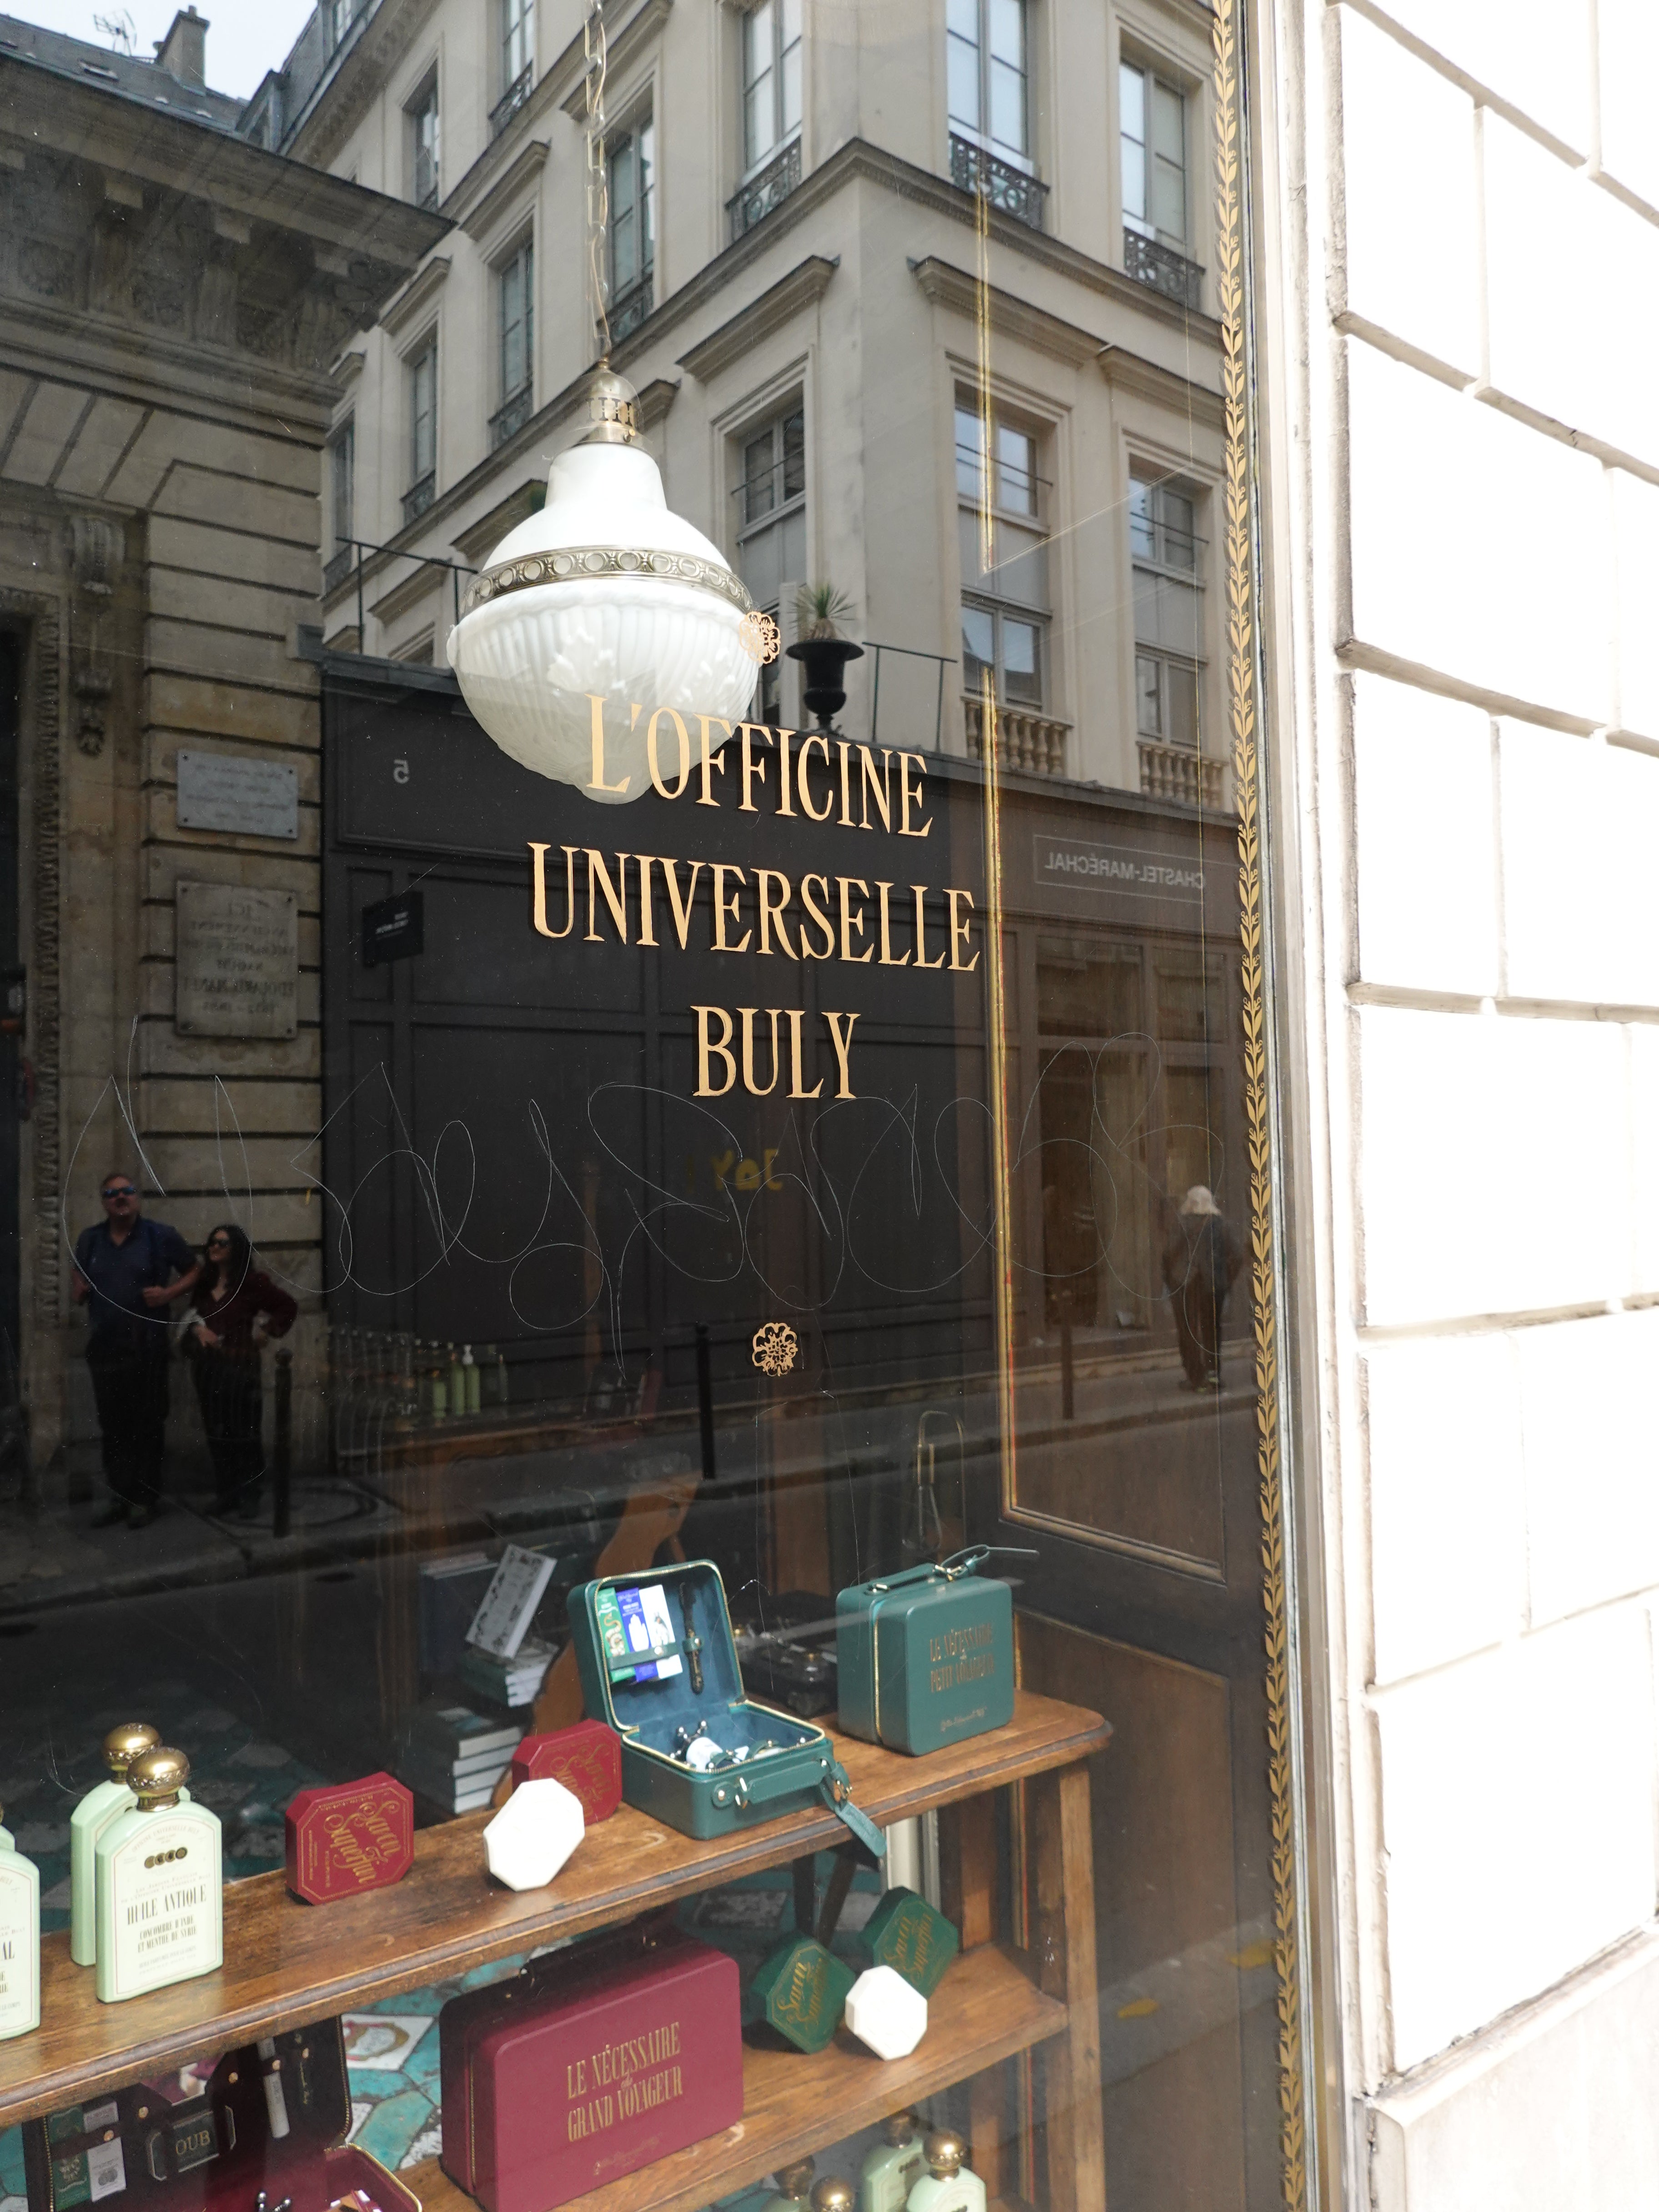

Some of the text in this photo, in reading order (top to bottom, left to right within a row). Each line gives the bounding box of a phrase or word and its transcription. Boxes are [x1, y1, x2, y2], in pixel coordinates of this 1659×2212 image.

[585, 694, 933, 837] L'OFFICINE
[527, 842, 980, 971] UNIVERSELLE
[691, 1006, 861, 1099] BULY
[127, 1884, 207, 1925] HUILE ANTIQUE
[139, 1921, 172, 1941] CONCOMBRE
[146, 1932, 169, 1951] MENTHE
[568, 2021, 681, 2100] LE NÉCESSAIRE
[568, 2066, 683, 2142] GRAND VOYAGEUR
[175, 2130, 211, 2157] OUB
